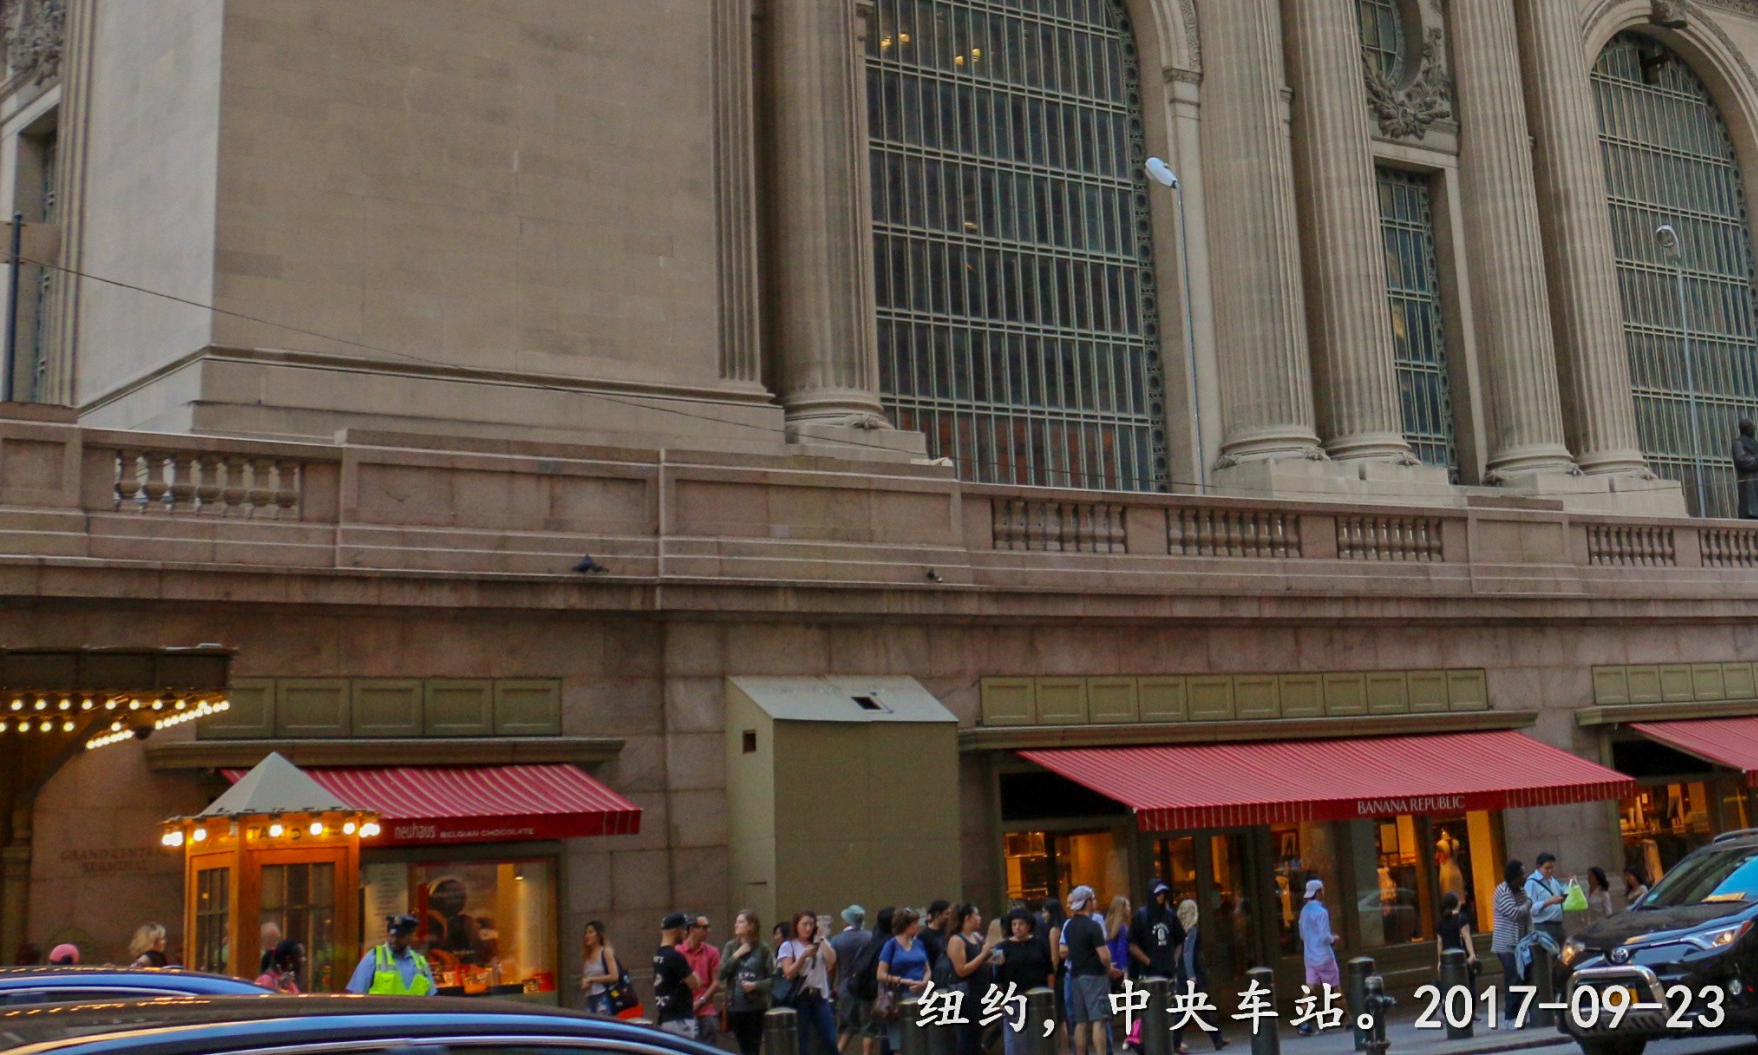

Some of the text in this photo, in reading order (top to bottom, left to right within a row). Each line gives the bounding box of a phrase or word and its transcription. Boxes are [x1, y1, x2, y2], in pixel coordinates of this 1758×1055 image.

[1357, 795, 1464, 814] BANANA REPUBLIC
[394, 823, 534, 839] neuhaus BELGIAN CHOCOLATE
